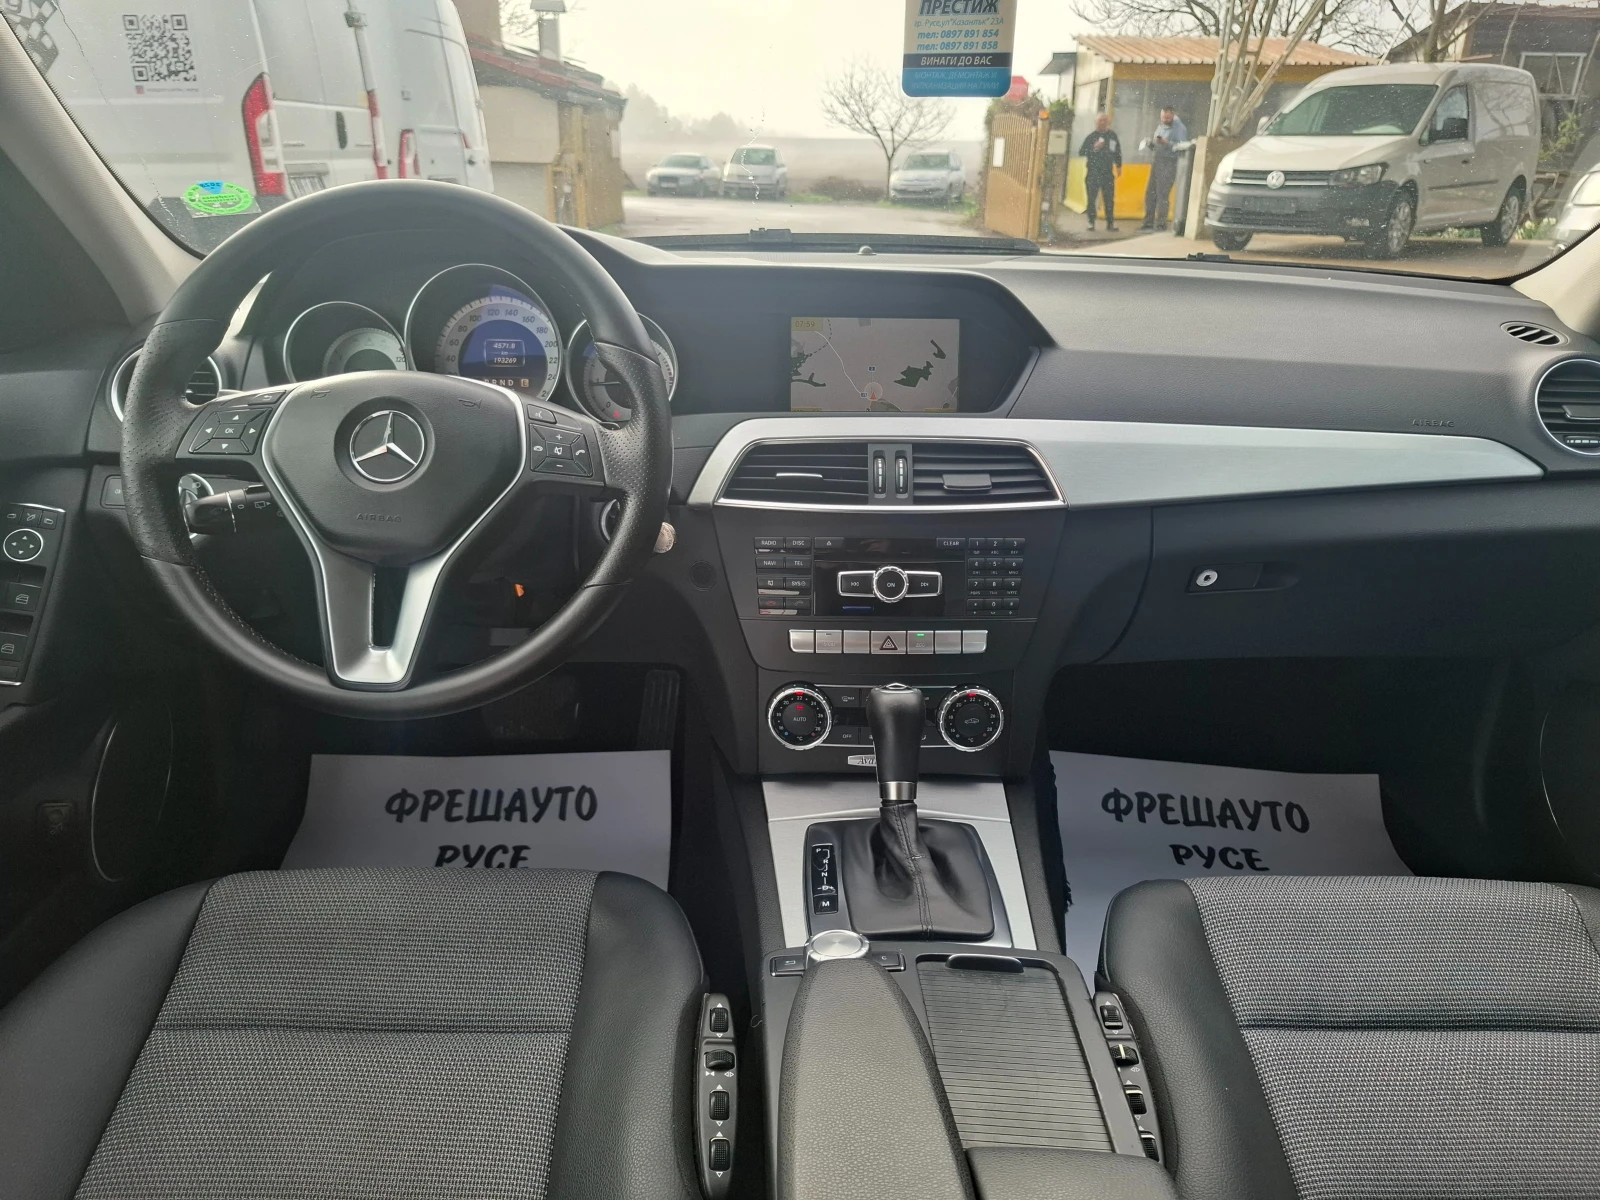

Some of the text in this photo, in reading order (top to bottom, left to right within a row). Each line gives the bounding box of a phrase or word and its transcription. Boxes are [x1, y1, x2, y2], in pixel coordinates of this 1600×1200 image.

[919, 0, 998, 15] ПРЕСТИЖ
[941, 30, 962, 39] 0897
[964, 30, 980, 38] 891
[982, 29, 999, 38] 854
[940, 42, 961, 50] 0897
[963, 42, 979, 50] 891
[981, 41, 998, 50] 858
[921, 56, 993, 67] ВИНАГИ ДО ВАС
[1411, 418, 1454, 428] AIRBAG
[225, 427, 235, 435] OK
[356, 512, 402, 523] AIRBAG
[385, 784, 598, 824] ФРЕШАУТО
[1101, 787, 1310, 834] ФРЕШАУТО
[434, 844, 532, 869] РУСЕ
[1169, 844, 1270, 872] РУСЕ
